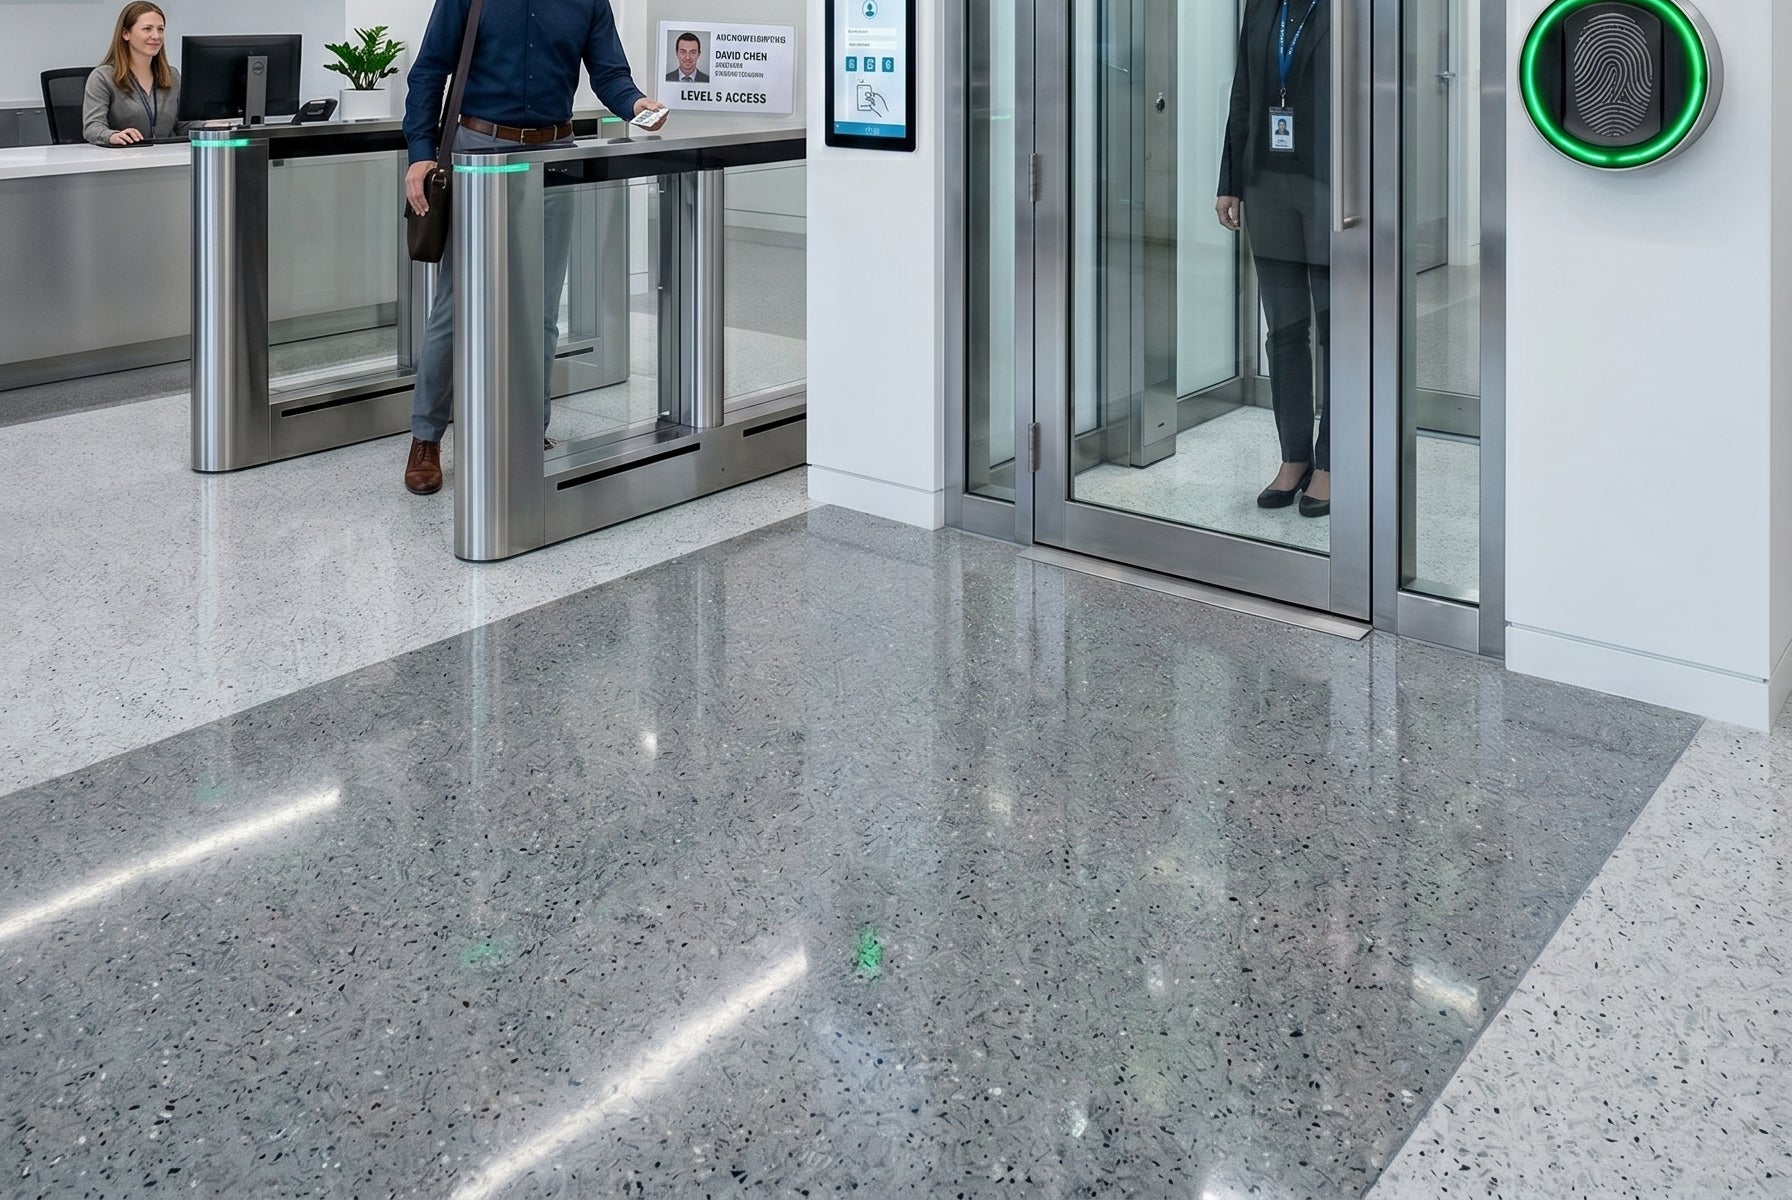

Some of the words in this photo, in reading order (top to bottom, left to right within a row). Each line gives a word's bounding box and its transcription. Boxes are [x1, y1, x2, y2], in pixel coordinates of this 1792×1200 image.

[715, 50, 741, 60] DAVID
[743, 51, 768, 61] CHEN
[680, 89, 713, 102] LEVEL
[725, 92, 767, 104] ACCESS
